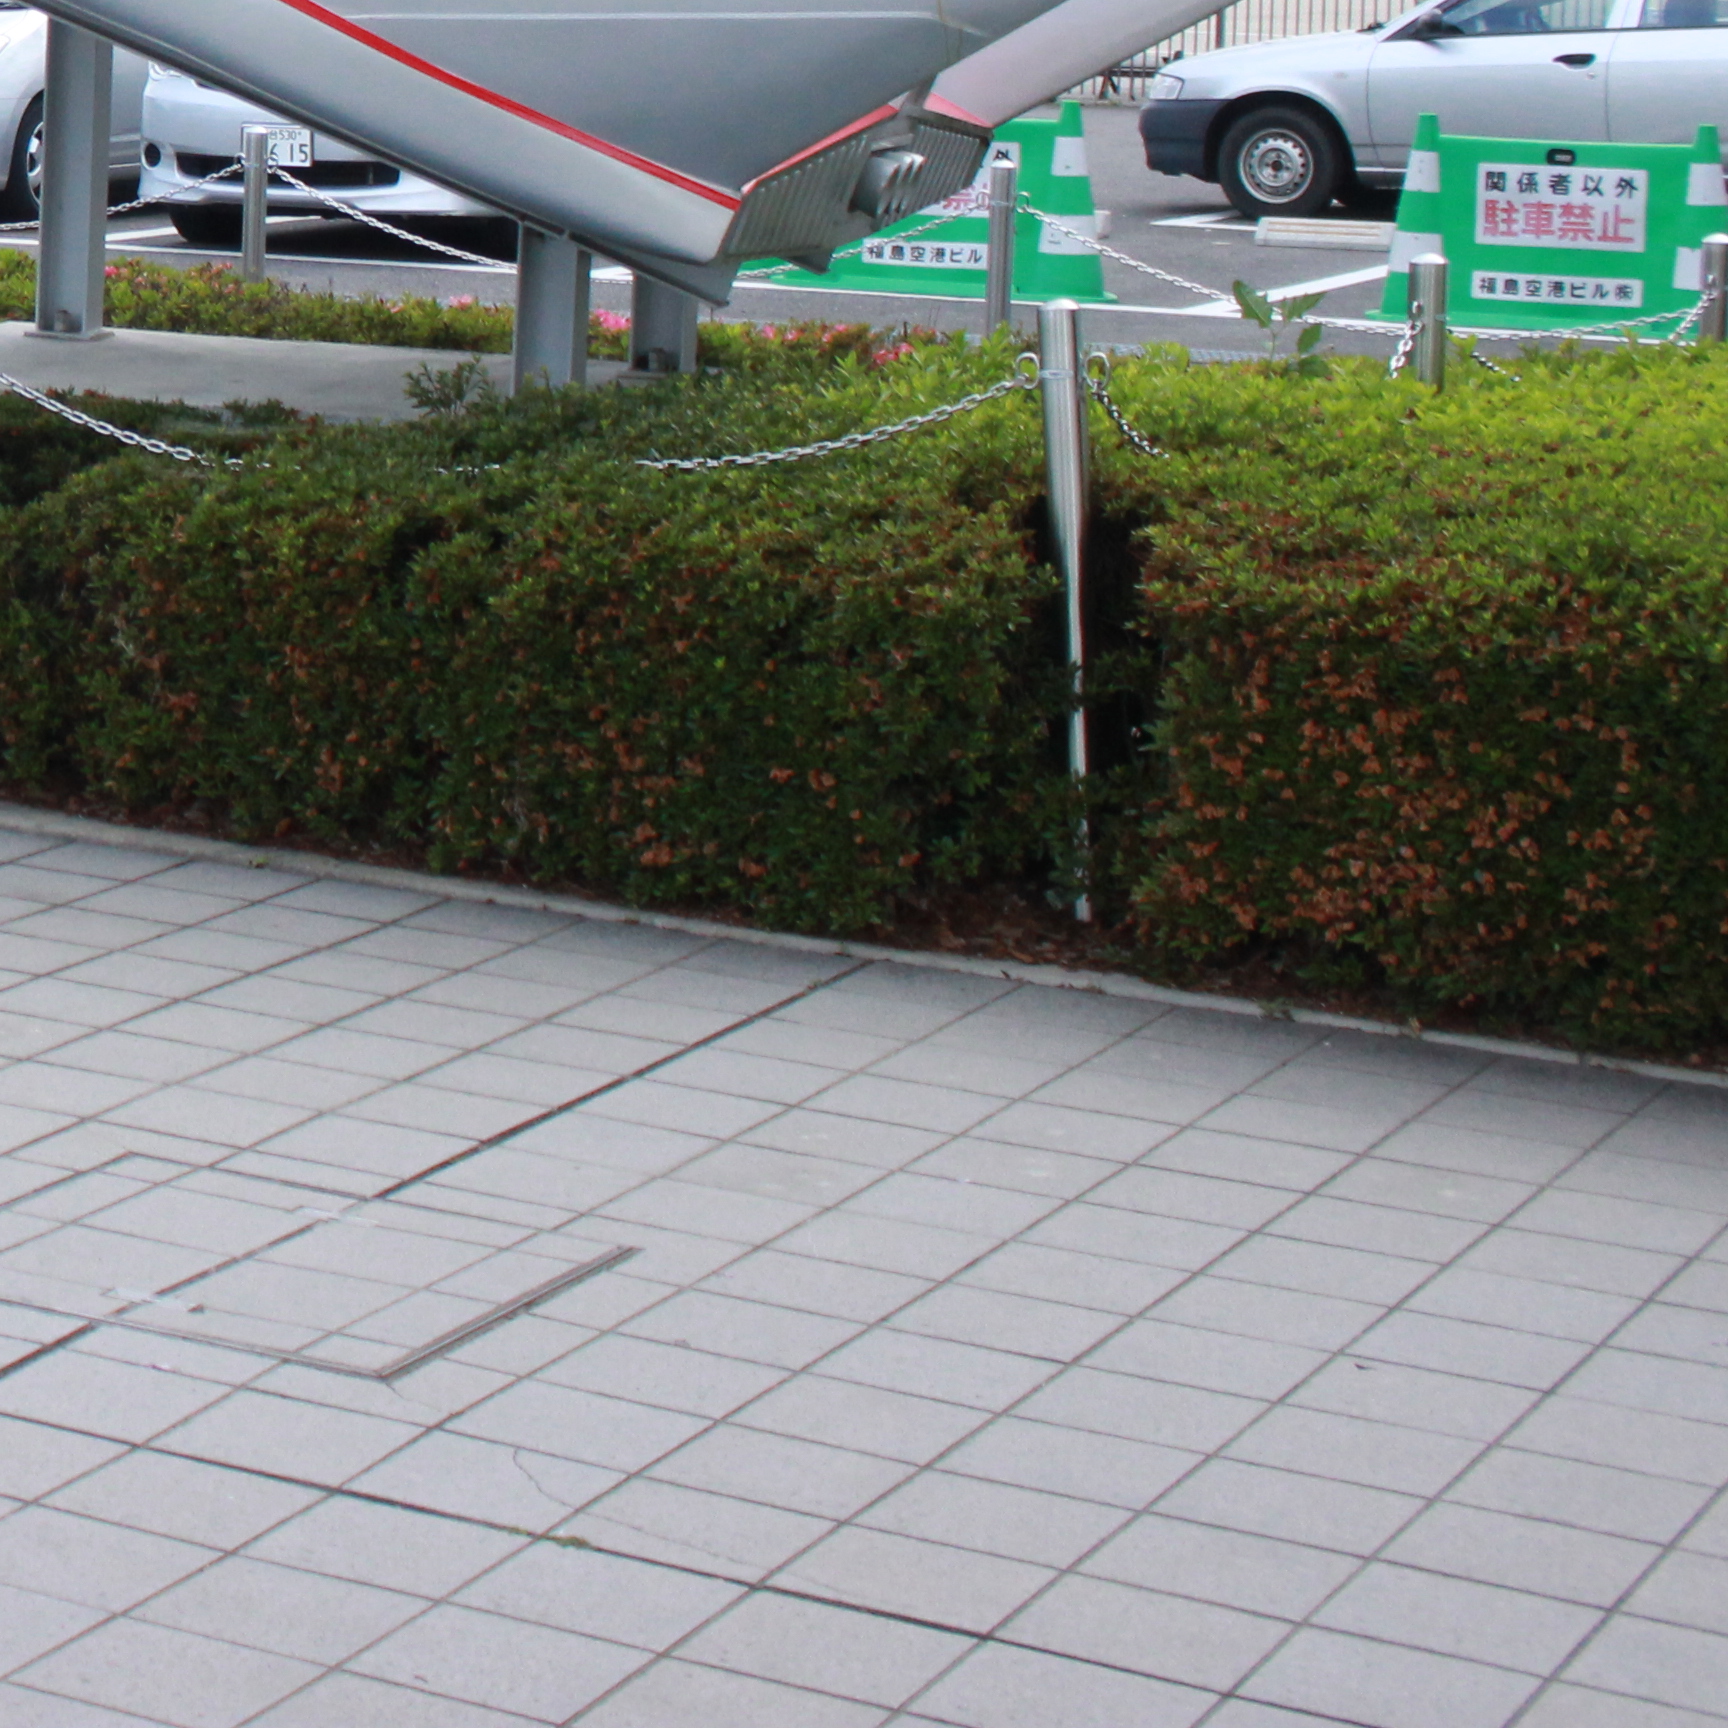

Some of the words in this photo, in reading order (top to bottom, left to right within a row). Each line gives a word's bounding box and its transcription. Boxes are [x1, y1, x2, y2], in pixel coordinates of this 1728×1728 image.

[1486, 171, 1638, 198] 関係者以外
[1484, 199, 1635, 243] 駐車禁止
[868, 244, 982, 264] 福島空港ビル
